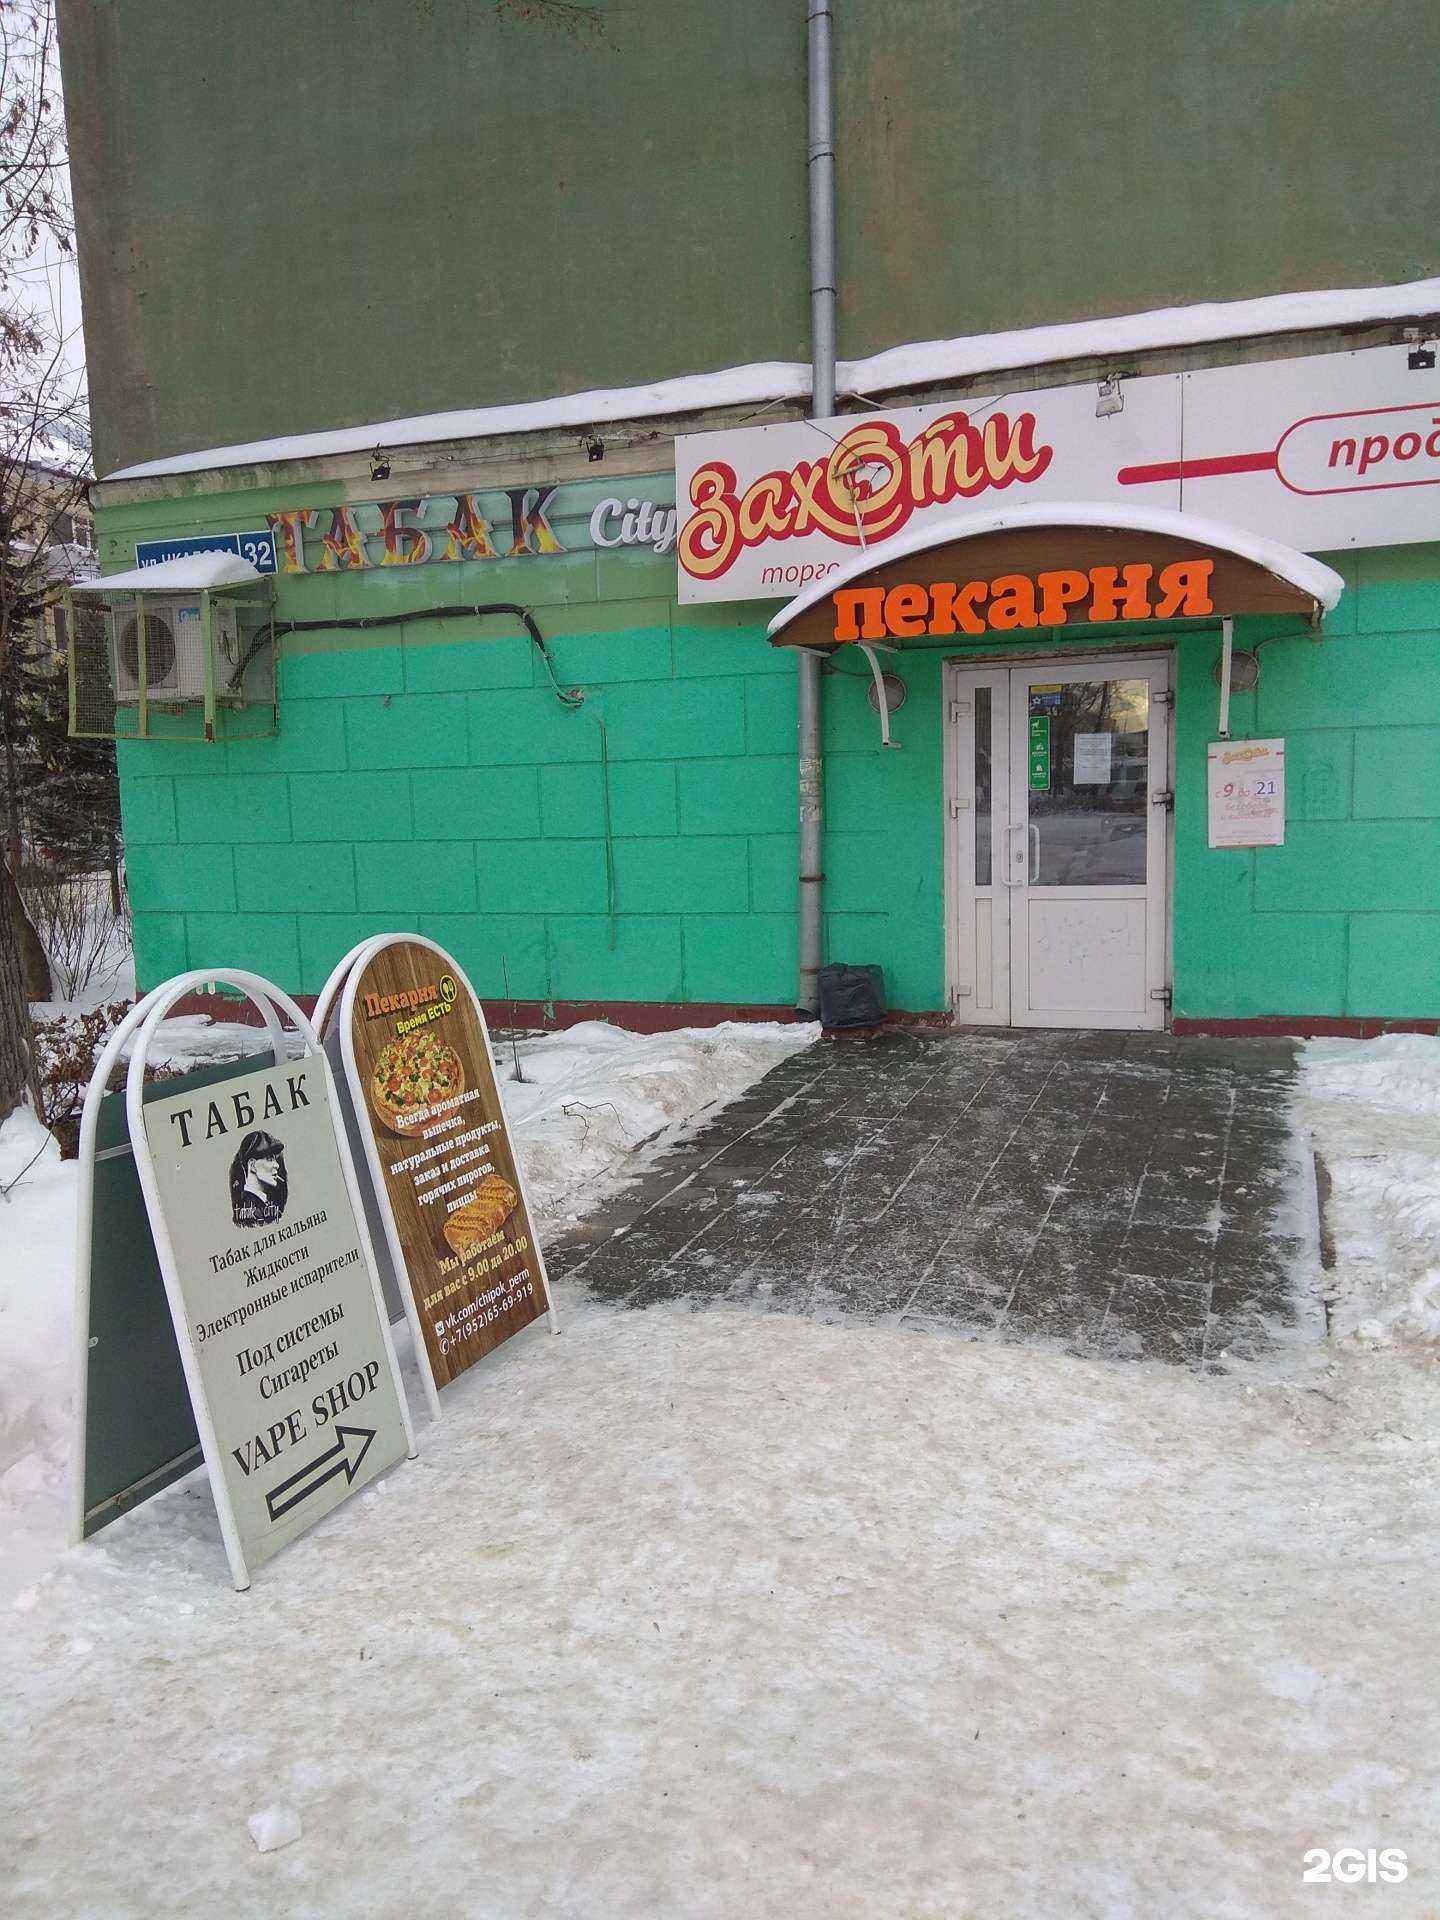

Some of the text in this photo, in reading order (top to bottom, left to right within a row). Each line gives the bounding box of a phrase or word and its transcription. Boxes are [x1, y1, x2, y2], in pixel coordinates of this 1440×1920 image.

[245, 541, 272, 567] 32
[265, 486, 678, 574] ТАБАК City
[1256, 781, 1276, 796] 21
[364, 984, 439, 1018] Пекарня
[396, 1001, 452, 1034] Время ЕСТЬ
[170, 1074, 311, 1148] ТАБАК
[395, 1089, 480, 1129] Всегда ароматная
[422, 1115, 466, 1140] выпечка,
[390, 1119, 501, 1175] натуральные продукты,
[413, 1143, 491, 1186] заказ и доставка
[417, 1162, 495, 1206] горячих пирогов,
[446, 1190, 479, 1213] пиццы
[209, 1209, 328, 1273] Табак для кальяна
[243, 1245, 310, 1287] Жидкости
[439, 1230, 505, 1275] Мы работаем
[196, 1248, 360, 1342] Электронные испарители
[423, 1290, 444, 1310] для
[444, 1279, 461, 1297] вас
[461, 1275, 468, 1285] с
[468, 1259, 490, 1281] 9.00
[502, 1236, 528, 1260] 20.00
[446, 1268, 530, 1329] vk.com/chipok_perm
[450, 1282, 533, 1346] +7(952)65-69-919
[235, 1303, 345, 1377] Под системы
[259, 1340, 340, 1400] Сигареты
[231, 1360, 380, 1477] VAPE SHOP
